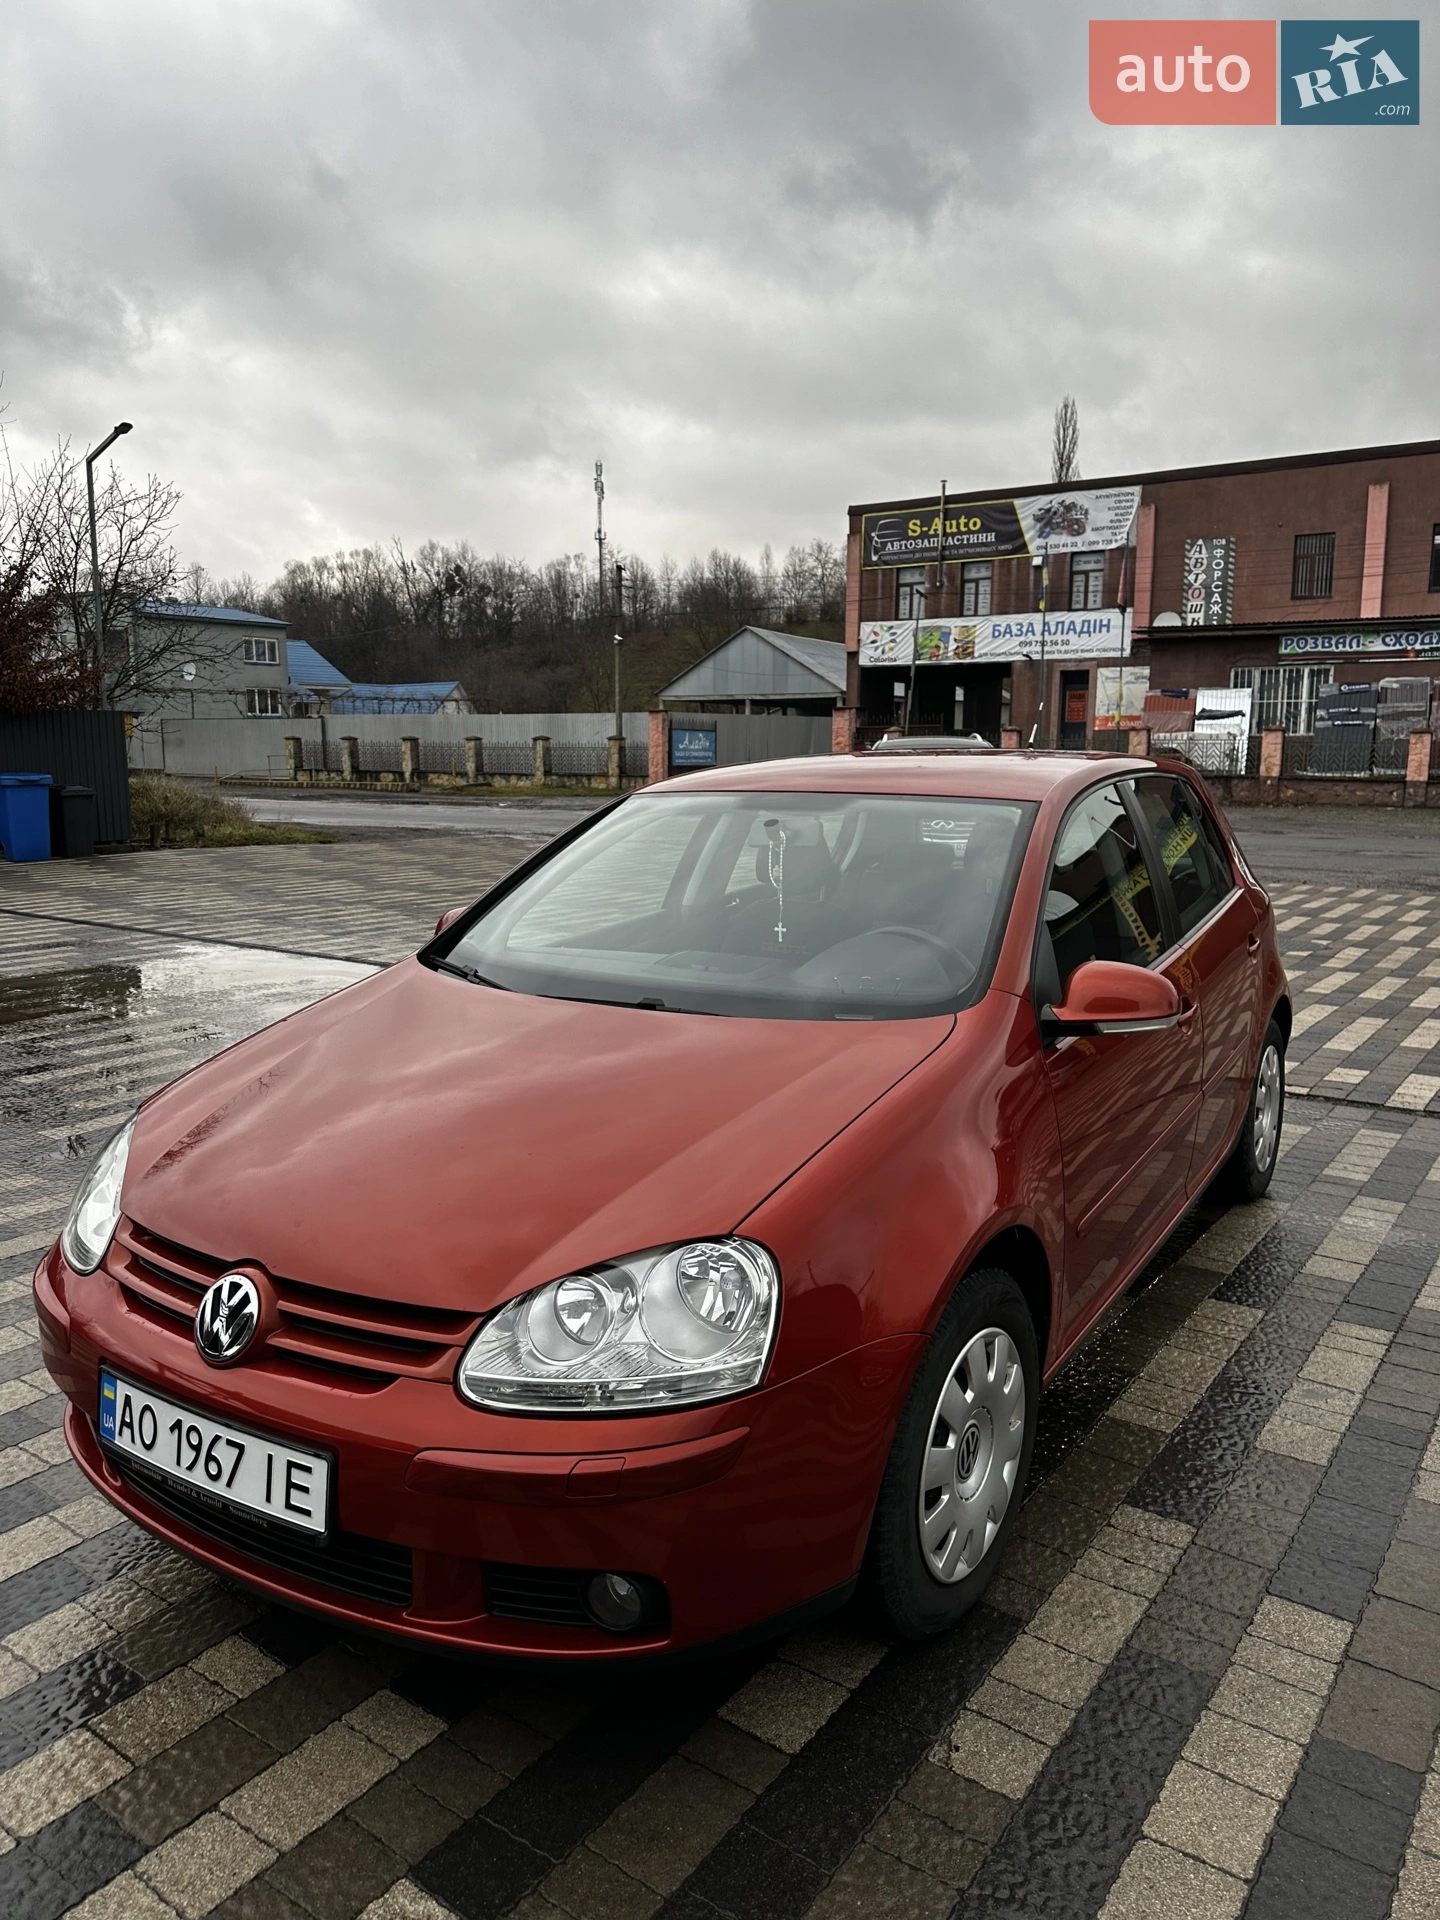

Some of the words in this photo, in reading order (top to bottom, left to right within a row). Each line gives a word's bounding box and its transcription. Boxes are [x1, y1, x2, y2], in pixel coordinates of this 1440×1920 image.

[907, 515, 982, 537] S-Auto
[1212, 538, 1227, 546] ТОВ
[992, 622, 1035, 638] БАЗА
[1041, 618, 1111, 637] АЛАДІН
[1018, 640, 1033, 648] 099
[1049, 639, 1059, 647] 56
[1060, 638, 1070, 646] 50
[1283, 634, 1362, 652] РОЗВАЛ
[103, 1413, 115, 1431] UA
[169, 1417, 246, 1489] 1967
